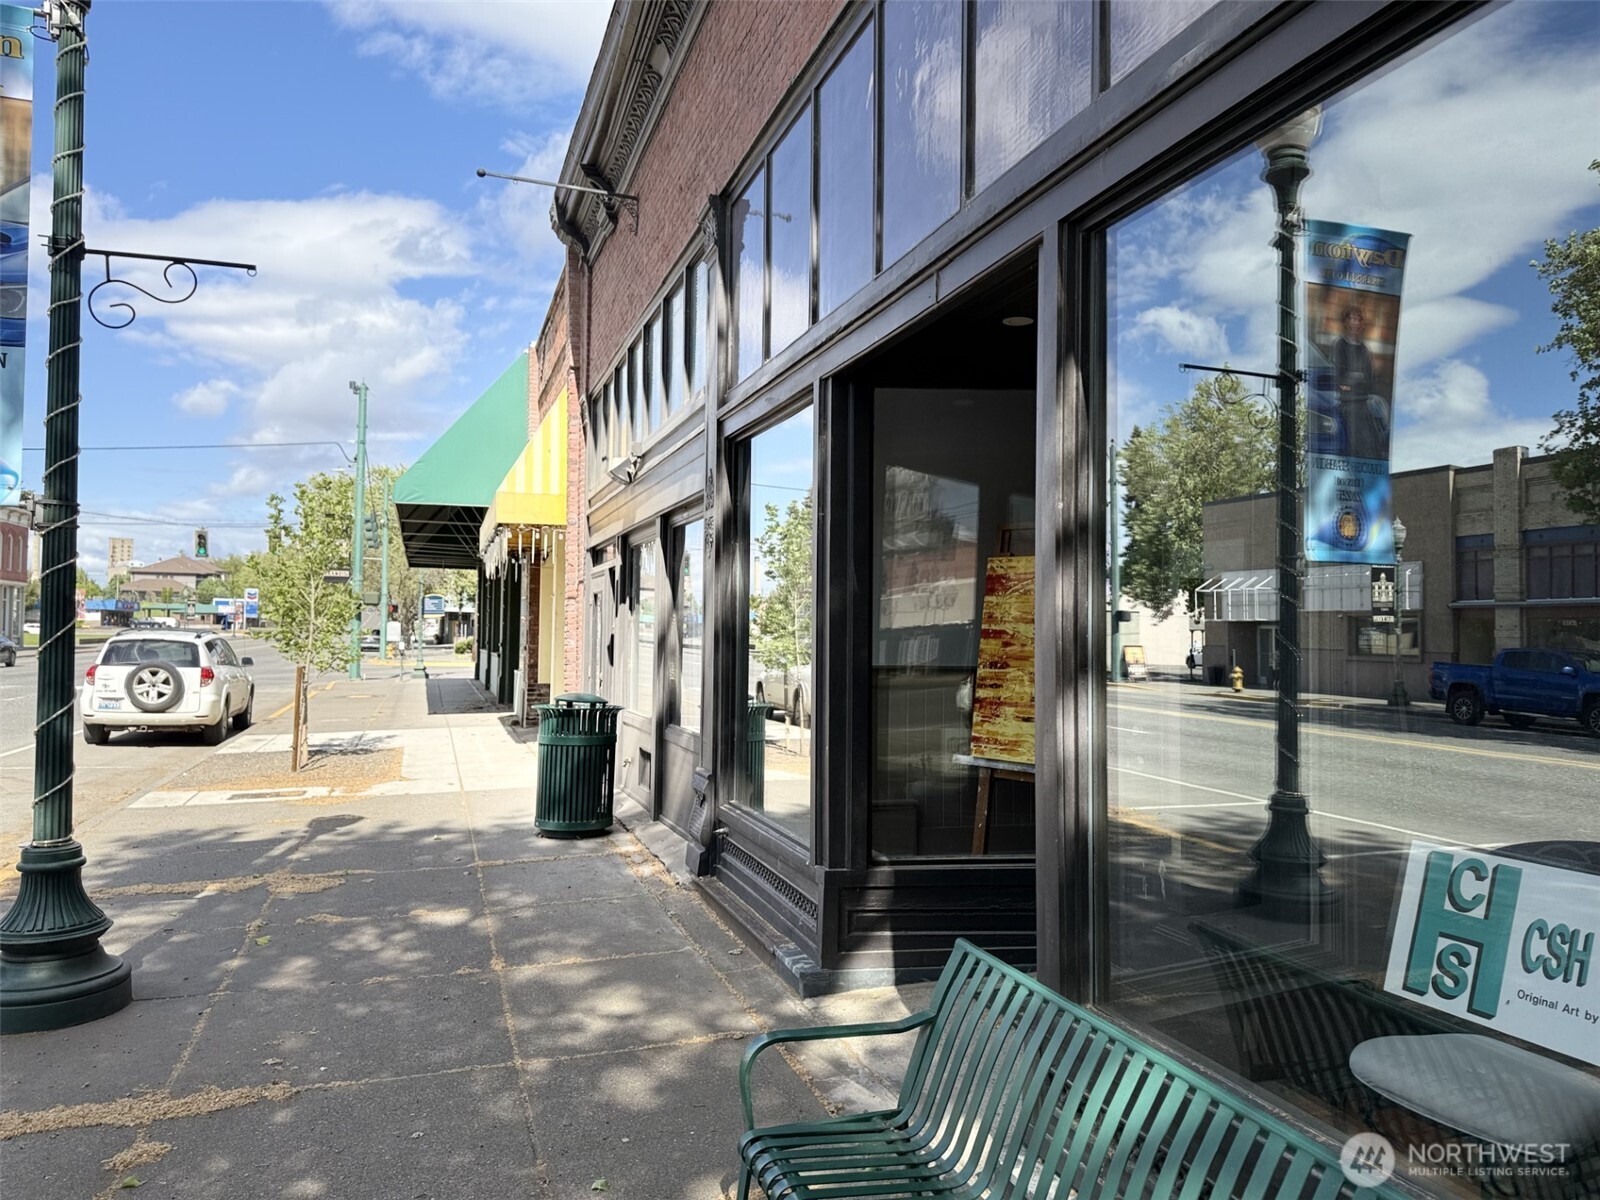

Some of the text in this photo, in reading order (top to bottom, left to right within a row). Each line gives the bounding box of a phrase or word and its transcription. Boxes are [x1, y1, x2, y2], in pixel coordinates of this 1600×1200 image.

[1521, 918, 1595, 988] CSH
[1517, 989, 1600, 1024] Original Art by
